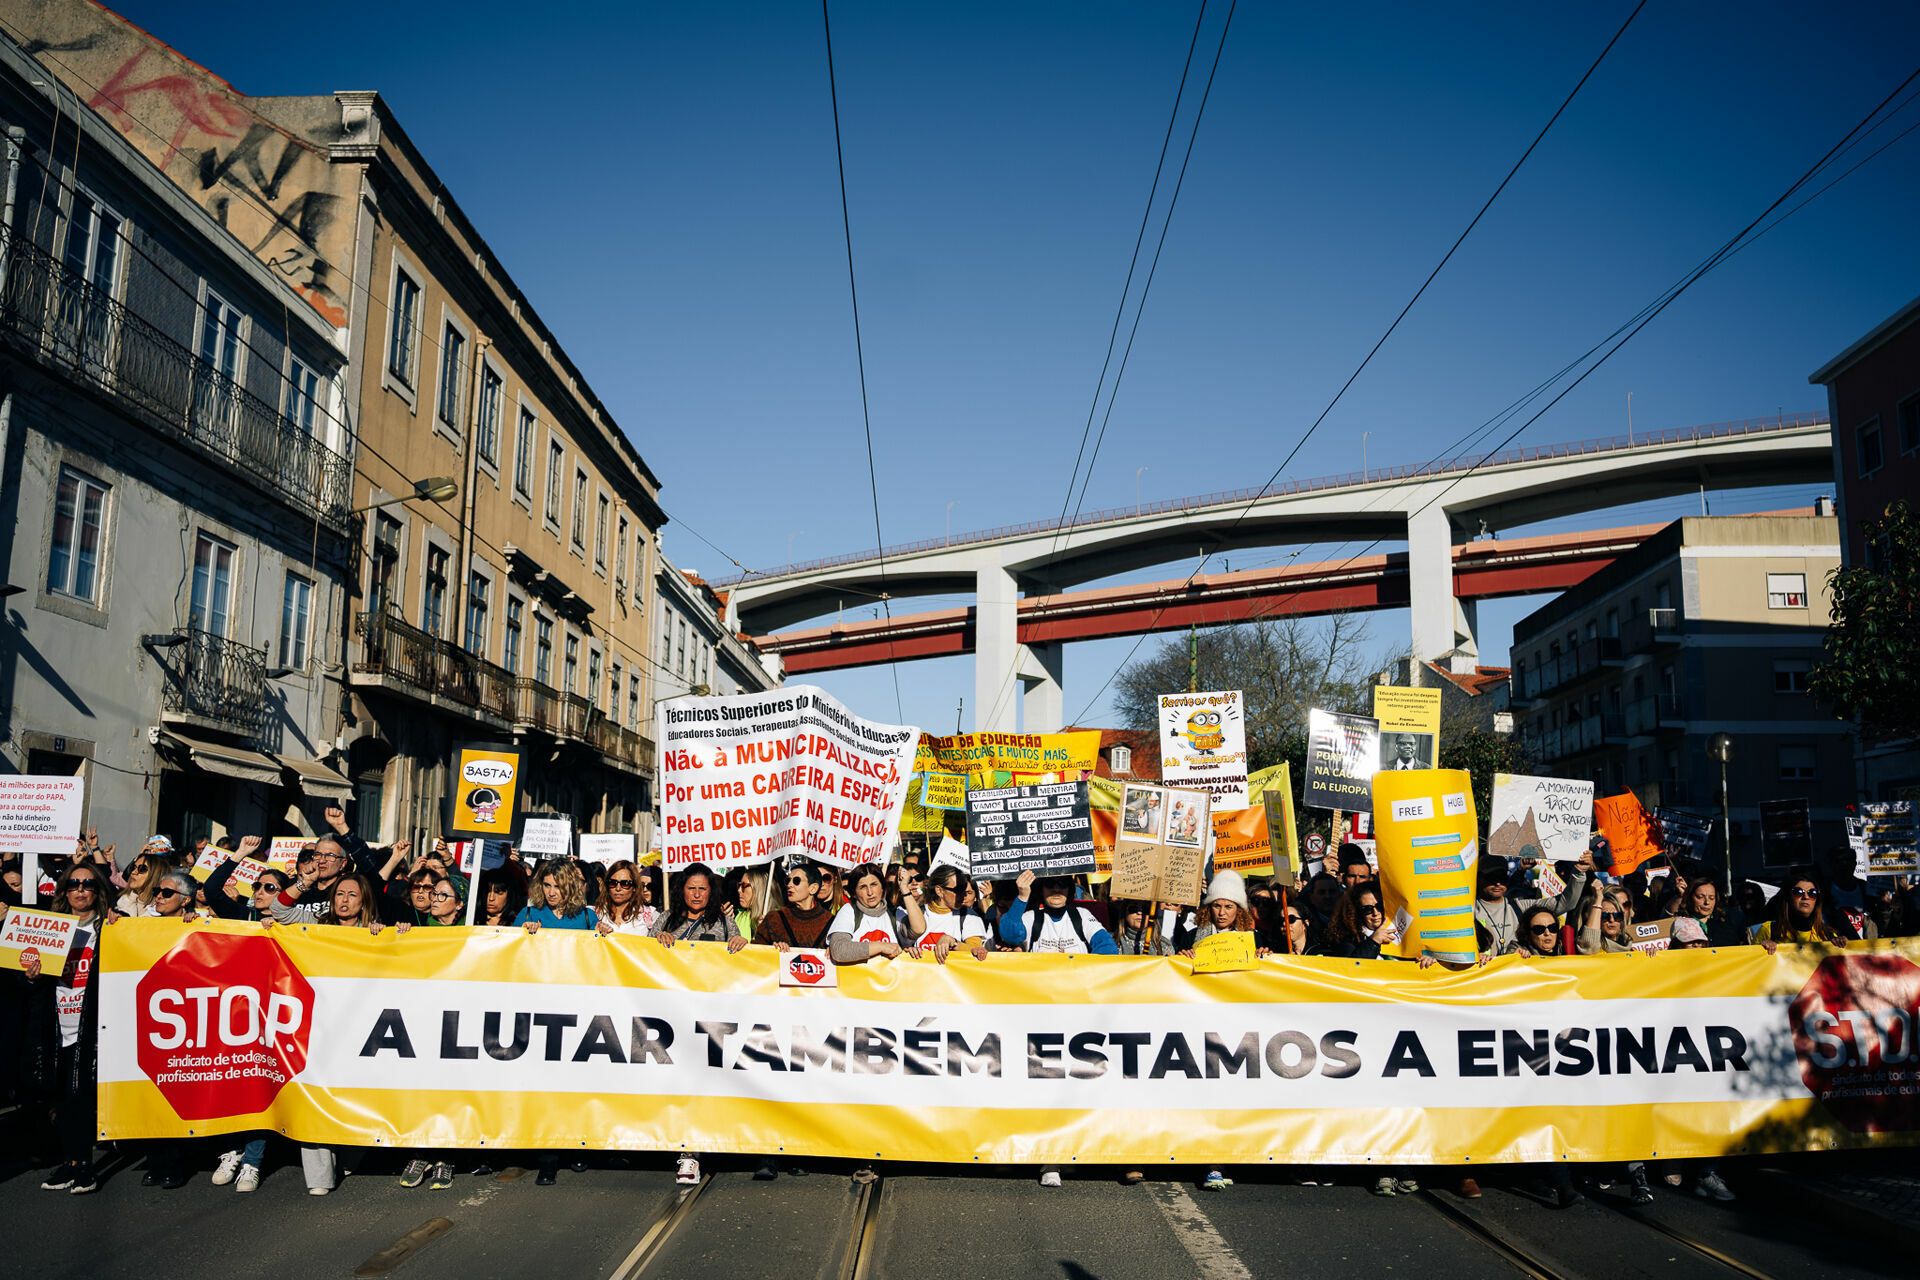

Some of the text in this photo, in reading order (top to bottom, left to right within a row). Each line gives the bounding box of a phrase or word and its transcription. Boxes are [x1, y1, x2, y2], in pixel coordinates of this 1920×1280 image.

[666, 708, 719, 724] Técnicos
[721, 699, 793, 721] Superiores
[796, 695, 808, 710] do
[850, 720, 860, 736] da
[668, 730, 714, 740] Educadores
[716, 726, 750, 738] Sociais,
[960, 733, 1042, 748] DA EDUCAÇÃO
[665, 749, 704, 772] Não
[714, 746, 728, 768] à
[998, 746, 1040, 760] E MUITOS
[1164, 757, 1180, 767] Ah
[466, 766, 512, 779] BASTA!
[1314, 766, 1330, 776] NA
[60, 782, 74, 790] TAP,
[666, 783, 694, 804] Por
[701, 781, 746, 800] uma
[752, 766, 834, 795] CARREIRA
[1164, 776, 1221, 787] CONTINUAMOS
[1312, 781, 1368, 795] DA EUROPA
[1535, 782, 1593, 795] A MONTANHA
[970, 784, 1076, 798] ESTABILIDADE MENTIRA!
[974, 802, 1002, 810] VAMOS
[1010, 799, 1047, 808] LECIONAR
[1399, 797, 1463, 816] FREE HUGS
[1544, 794, 1583, 811] PARIU
[666, 798, 824, 834] Pela DIGNIDADE NA
[1022, 810, 1070, 820] AGRUPAMENTOS
[1539, 813, 1558, 823] UM
[988, 826, 1003, 835] KM
[1044, 819, 1086, 830] DESGASTE
[1011, 834, 1059, 844] BUROCRACIA
[667, 842, 726, 864] DIREITO
[732, 840, 752, 858] DE
[828, 835, 838, 858] À
[984, 849, 1021, 860] EXTINÇÃO
[1226, 842, 1255, 853] FAMÍLIAS
[10, 915, 70, 933] A LUTAR
[1638, 925, 1658, 936] Sem
[6, 933, 65, 948] A ENSINAR
[358, 1008, 1750, 1080] A LUTAR TAMBÉM ESTAMOS A ENSINAR
[167, 1054, 212, 1068] sindicato
[214, 1053, 230, 1066] de
[232, 1050, 267, 1064] tod@s
[157, 1064, 286, 1086] profissionais de educação
